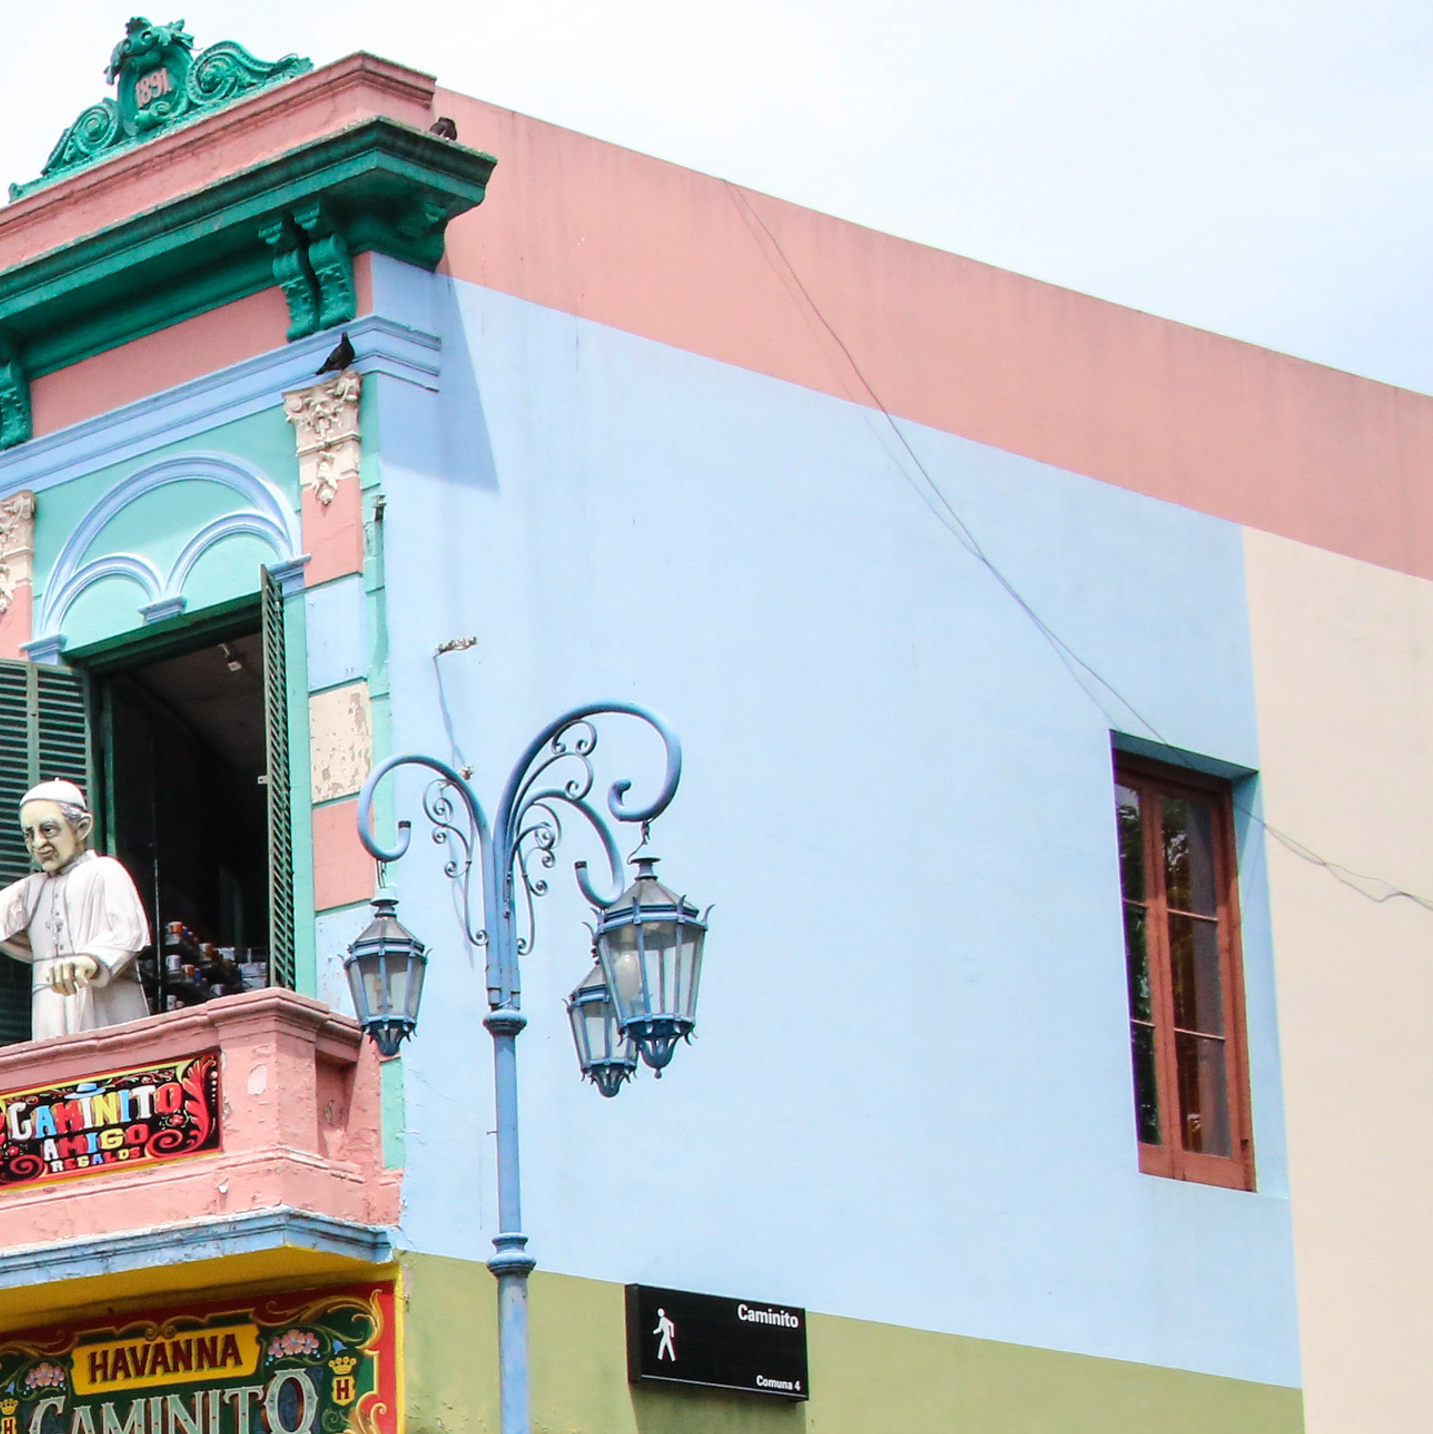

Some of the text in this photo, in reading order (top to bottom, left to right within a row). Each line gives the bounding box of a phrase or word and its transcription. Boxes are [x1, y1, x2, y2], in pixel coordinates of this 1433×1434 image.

[135, 68, 171, 108] 1891
[7, 1082, 183, 1141] CAMINITO
[43, 1123, 149, 1162] AMIGO
[50, 1146, 141, 1173] REGALOS
[737, 1304, 799, 1328] Caminito
[88, 1331, 244, 1384] HAVANNA
[336, 1378, 349, 1400] H
[756, 1375, 801, 1391] Comuna 4
